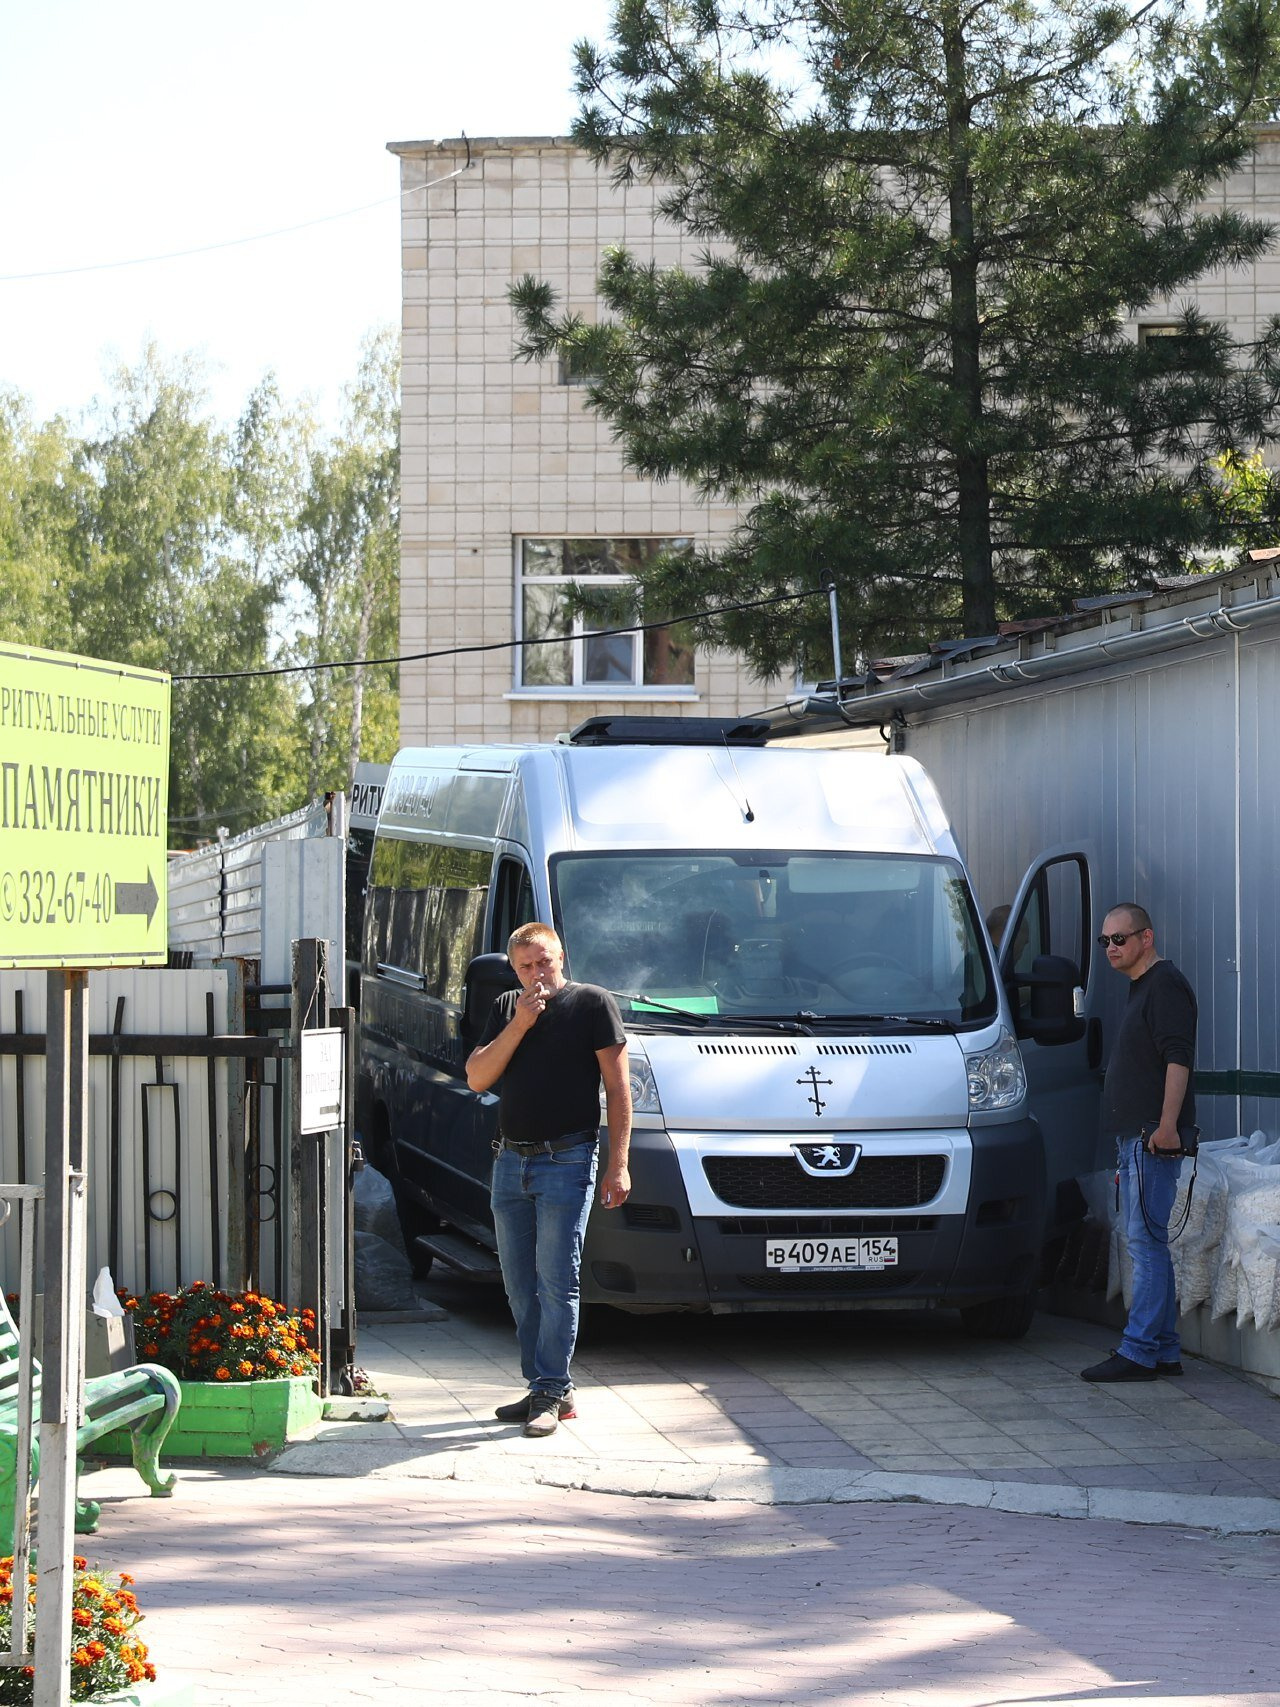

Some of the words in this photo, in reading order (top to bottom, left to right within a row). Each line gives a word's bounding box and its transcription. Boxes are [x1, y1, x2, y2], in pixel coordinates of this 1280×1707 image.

[1, 687, 109, 738] РИТУАЛЬНЫЕ
[112, 703, 161, 745] УСЛУГИ
[1, 762, 161, 837] ПАМЯТНИКИ
[19, 869, 112, 924] 332-67-40
[773, 1242, 856, 1264] В409АЕ
[861, 1239, 893, 1256] 154
